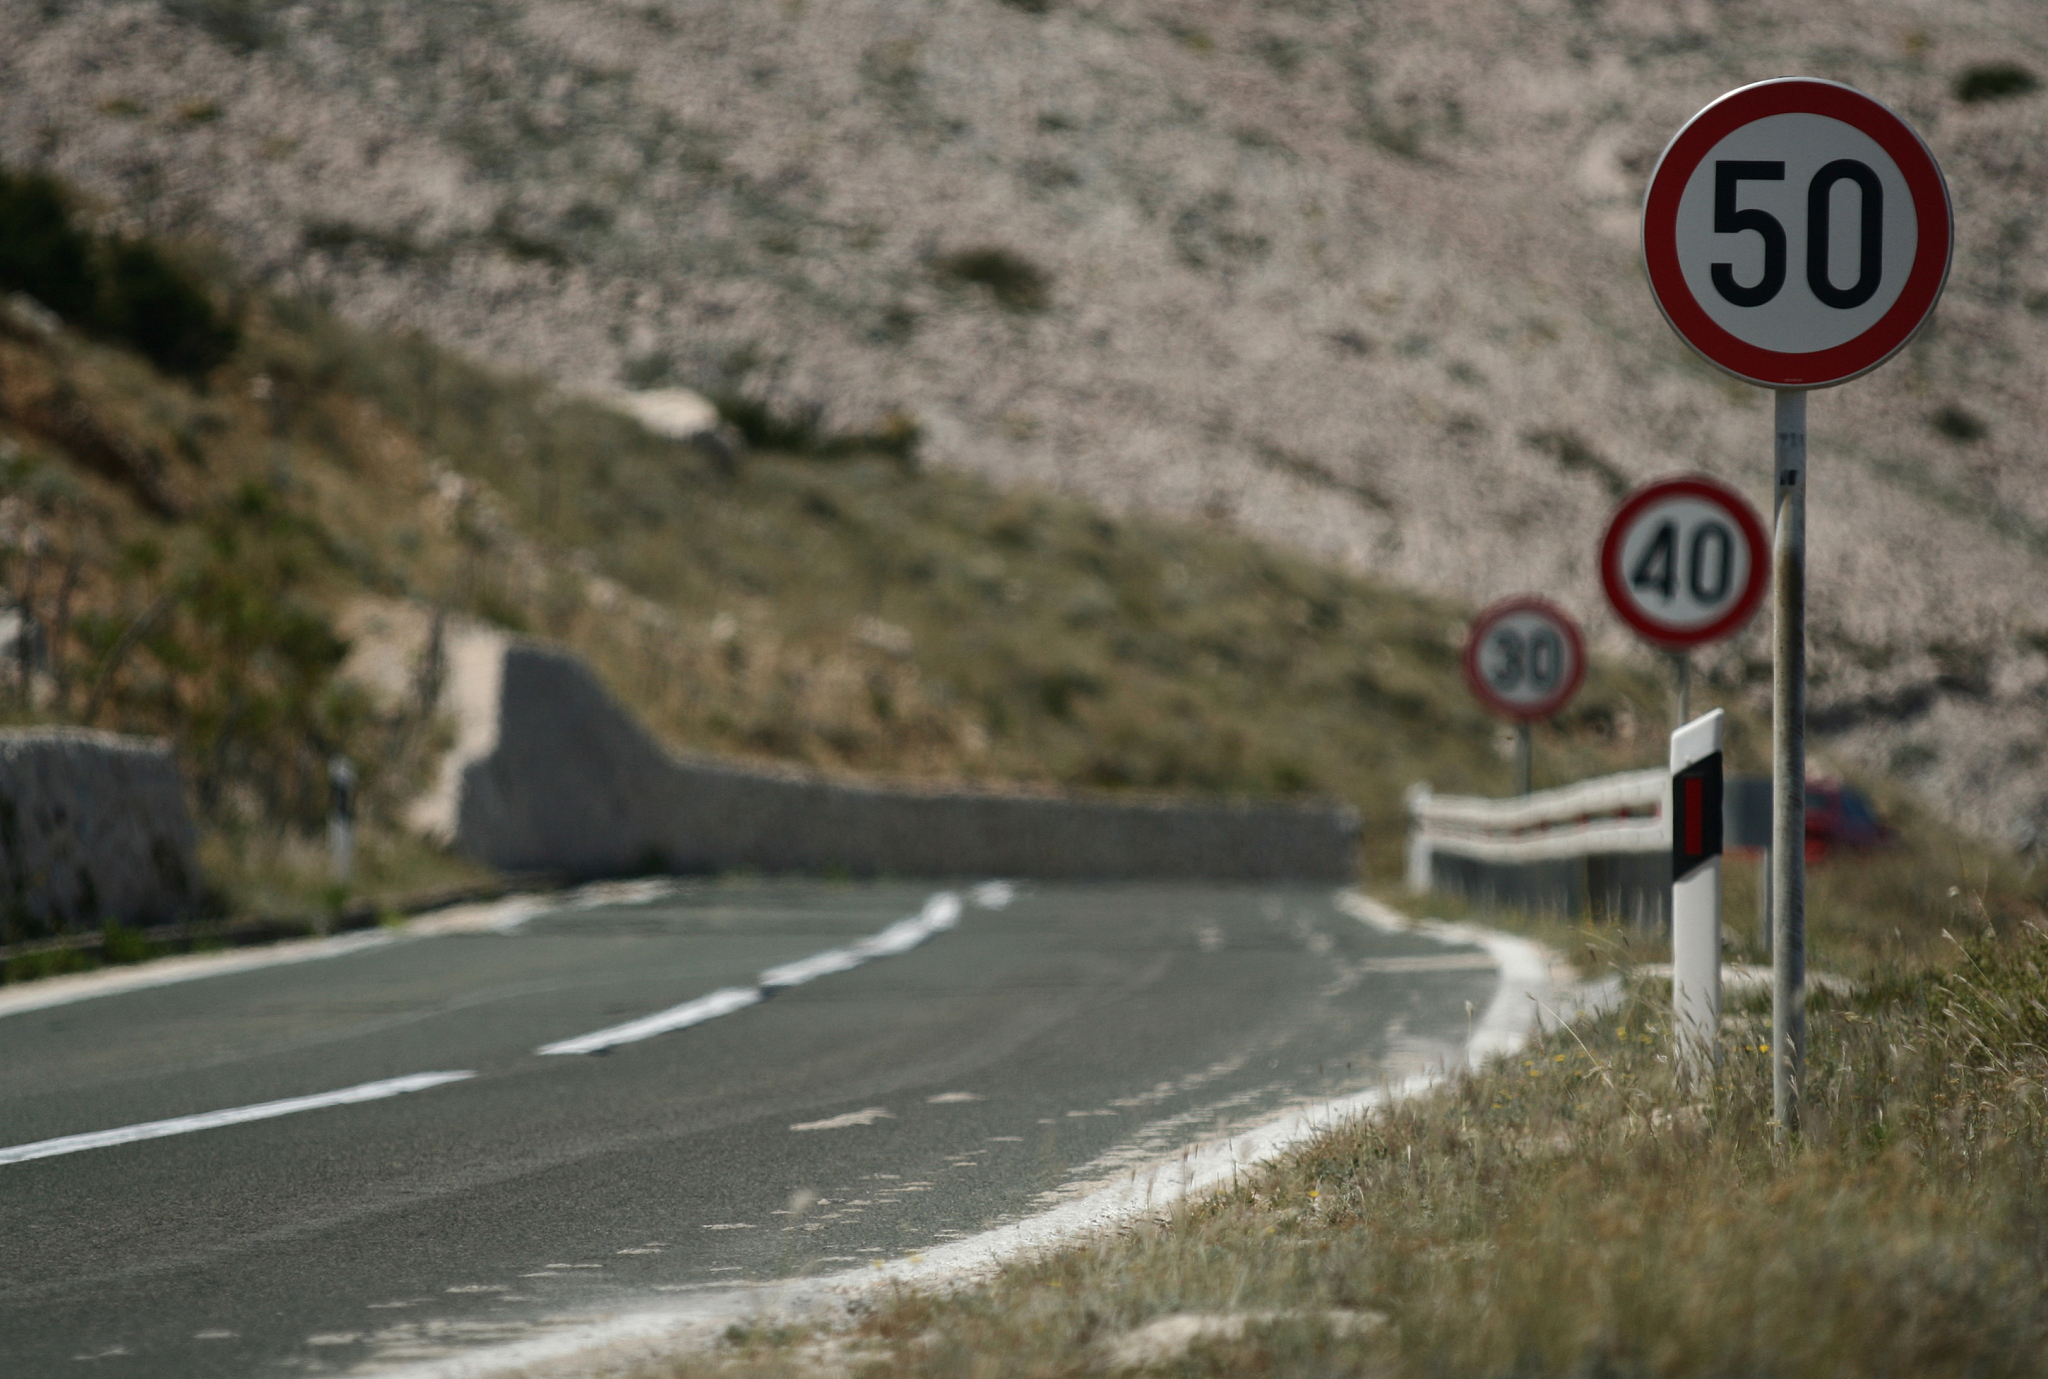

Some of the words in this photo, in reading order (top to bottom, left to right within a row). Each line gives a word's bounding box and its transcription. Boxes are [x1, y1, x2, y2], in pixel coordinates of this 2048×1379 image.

[1711, 158, 1883, 309] 50
[1632, 519, 1735, 603] 40
[1492, 628, 1563, 691] 30
